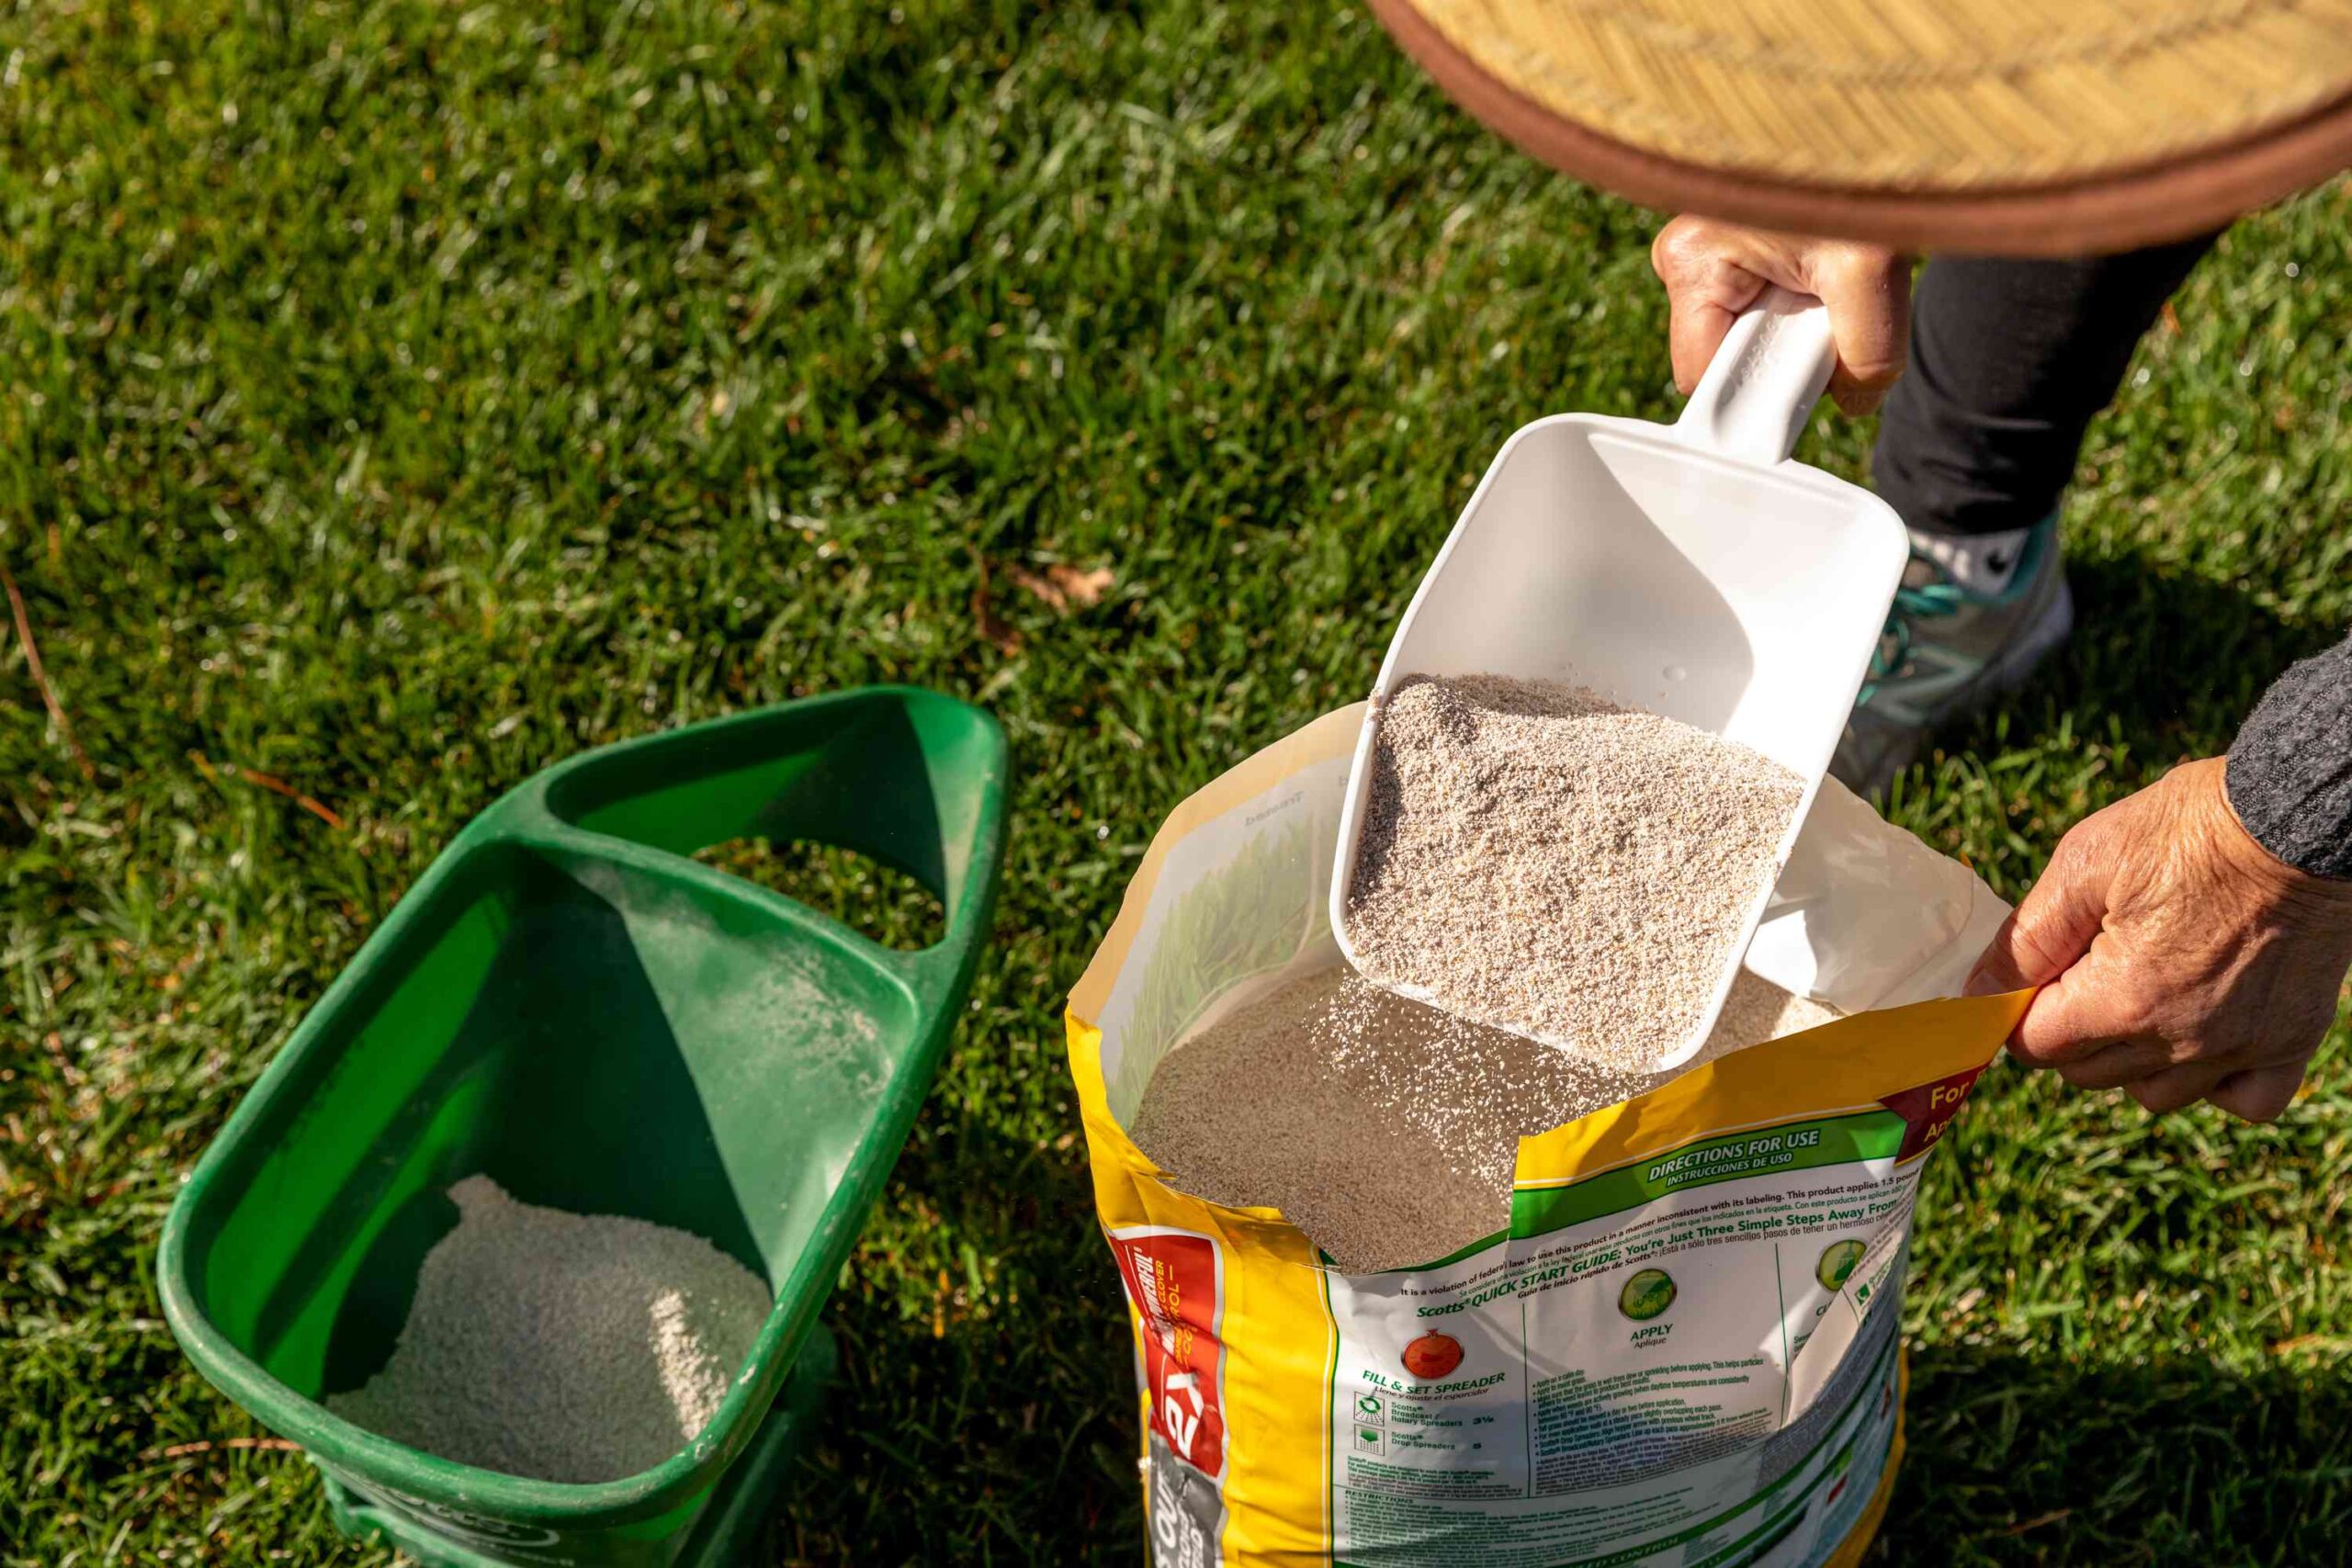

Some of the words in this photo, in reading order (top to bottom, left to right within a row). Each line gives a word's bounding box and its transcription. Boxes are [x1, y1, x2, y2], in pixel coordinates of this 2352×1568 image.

[1930, 1082, 1970, 1110] For
[1649, 1144, 1743, 1181] DIRECTIONS
[1748, 1136, 1781, 1155] FOR
[1787, 1131, 1819, 1147] USE
[1668, 1159, 1749, 1186] INSTRUCCIONES
[1752, 1156, 1767, 1168] DE
[1770, 1153, 1792, 1165] USO
[1411, 1288, 1418, 1296] is
[1430, 1280, 1467, 1295] violation
[1468, 1274, 1477, 1284] of
[1510, 1259, 1525, 1268] law
[1538, 1251, 1553, 1259] use
[1555, 1246, 1571, 1256] this
[1573, 1236, 1607, 1253] product
[1625, 1219, 1655, 1234] manner
[1657, 1205, 1708, 1223] inconsistent
[1711, 1201, 1730, 1211] with
[1733, 1198, 1744, 1207] its
[1746, 1192, 1785, 1205] labeling.
[1787, 1190, 1805, 1200] This
[1808, 1186, 1844, 1199] product
[1847, 1180, 1879, 1192] applies
[1881, 1178, 1894, 1186] 1.5
[1550, 1258, 1560, 1267] ley
[1613, 1234, 1641, 1249] producto
[1642, 1229, 1653, 1237] con
[1655, 1225, 1670, 1234] otros
[1671, 1220, 1687, 1229] fines
[1688, 1218, 1700, 1226] que
[1713, 1210, 1744, 1220] indicados
[1763, 1203, 1793, 1213] etiqueta.
[1795, 1201, 1809, 1209] Con
[1811, 1199, 1826, 1208] este
[1826, 1195, 1858, 1207] producto
[1868, 1190, 1890, 1201] aplican
[1417, 1299, 1470, 1318] Scotts®
[1471, 1280, 1518, 1307] QUICK
[1521, 1265, 1569, 1289] START
[1571, 1249, 1622, 1273] GUIDE:
[1668, 1231, 1693, 1245] Just
[1697, 1224, 1735, 1237] Three
[1738, 1216, 1783, 1232] Simple
[1786, 1212, 1824, 1226] Steps
[1828, 1207, 1865, 1221] Away
[1868, 1199, 1897, 1212] From
[1539, 1282, 1552, 1292] de
[1554, 1276, 1578, 1289] inicio
[1580, 1265, 1610, 1280] rápido
[1611, 1261, 1623, 1270] de
[1688, 1239, 1705, 1249] sólo
[1706, 1235, 1723, 1246] tres
[1724, 1231, 1761, 1243] sencillos
[1763, 1228, 1788, 1239] pasos
[1790, 1226, 1801, 1235] de
[1803, 1224, 1825, 1234] tener
[1826, 1223, 1838, 1231] un
[1839, 1217, 1874, 1229] hermoso
[1155, 1259, 1167, 1303] CLOVER
[1630, 1323, 1673, 1341] APPLY
[1634, 1337, 1668, 1348] Aplique
[1362, 1370, 1387, 1387] FILL
[1391, 1381, 1402, 1392] &
[1407, 1386, 1433, 1394] SET
[1435, 1372, 1506, 1393] SPREADER
[1374, 1386, 1396, 1397] Llene
[1405, 1393, 1432, 1402] ajuste
[1443, 1388, 1489, 1401] esparcidor
[1391, 1409, 1432, 1419] Broadcast
[1391, 1416, 1419, 1425] Rotary
[1391, 1438, 1411, 1447] Drop
[1413, 1440, 1455, 1450] Spreaders
[1345, 1490, 1414, 1505] RESTRICTIONS
